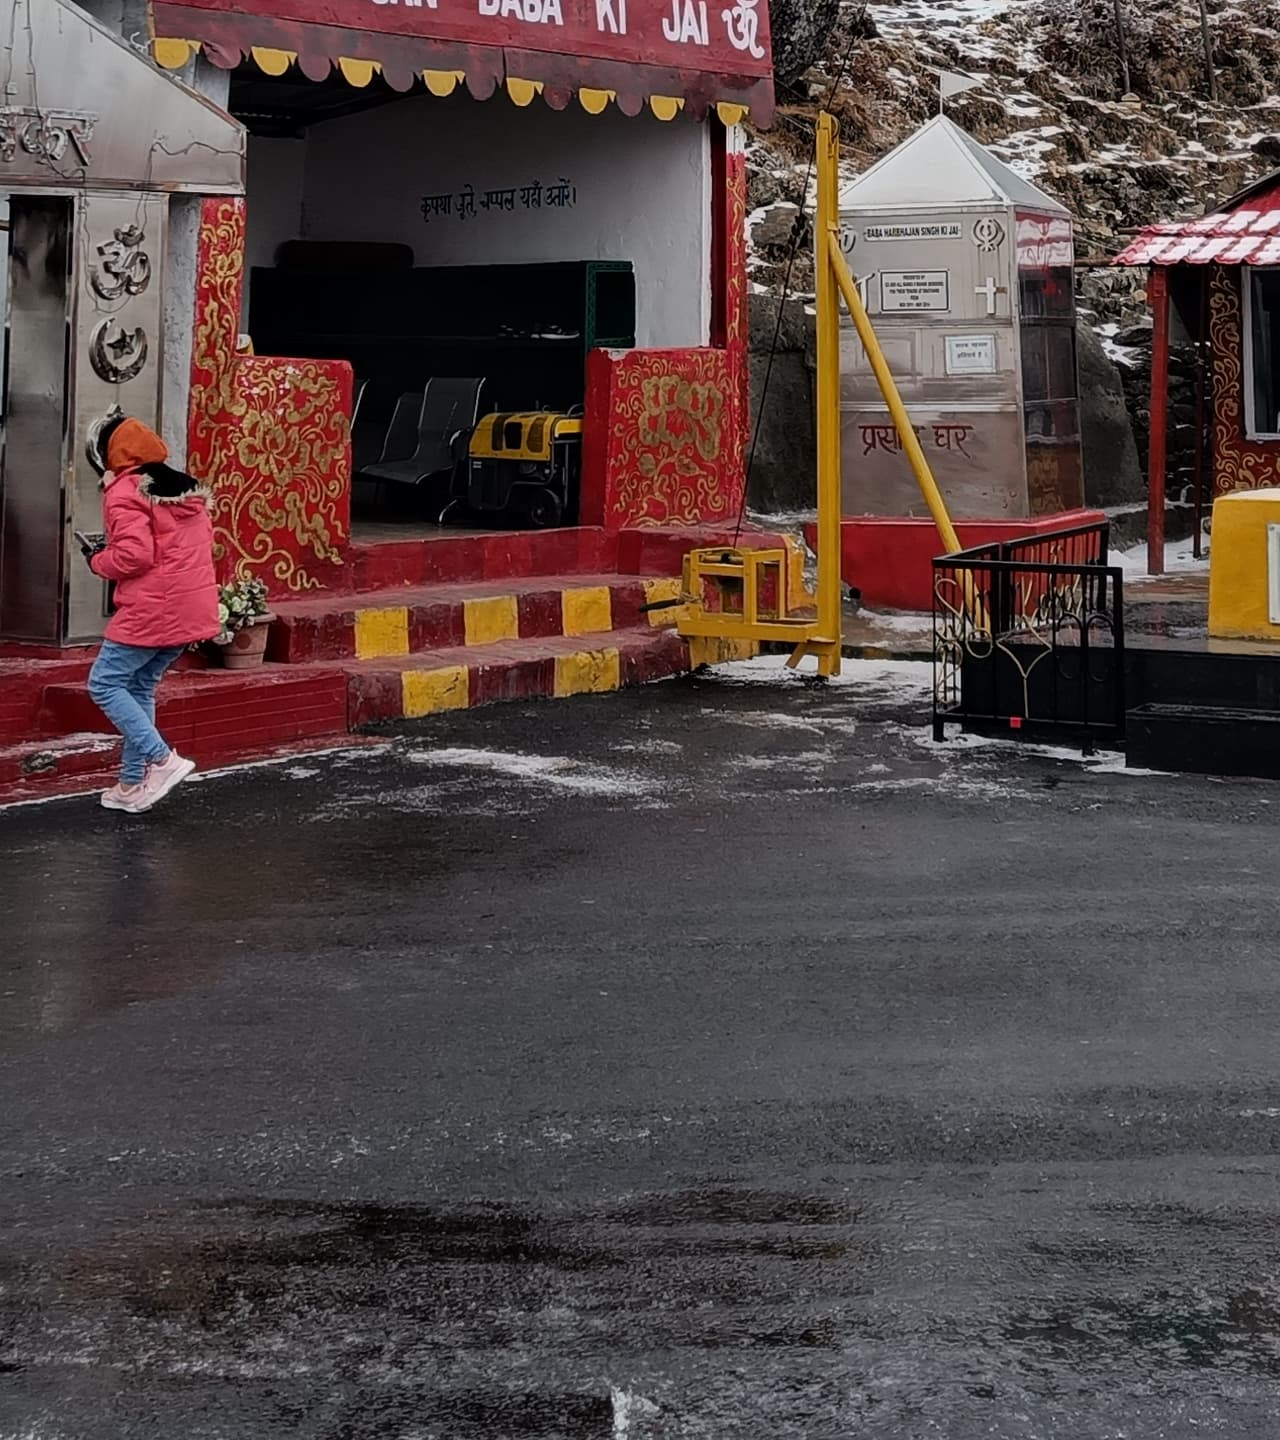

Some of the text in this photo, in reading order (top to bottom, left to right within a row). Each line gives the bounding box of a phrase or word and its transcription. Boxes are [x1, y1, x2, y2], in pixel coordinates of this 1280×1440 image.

[421, 193, 453, 223] कृपया
[480, 187, 517, 212] चप्पल
[520, 179, 543, 209] यहाँ
[866, 227, 883, 239] BABA
[884, 226, 920, 238] HARBHAJAN
[921, 225, 940, 237] SINGH
[949, 224, 959, 236] JAI
[932, 426, 974, 459] घर
